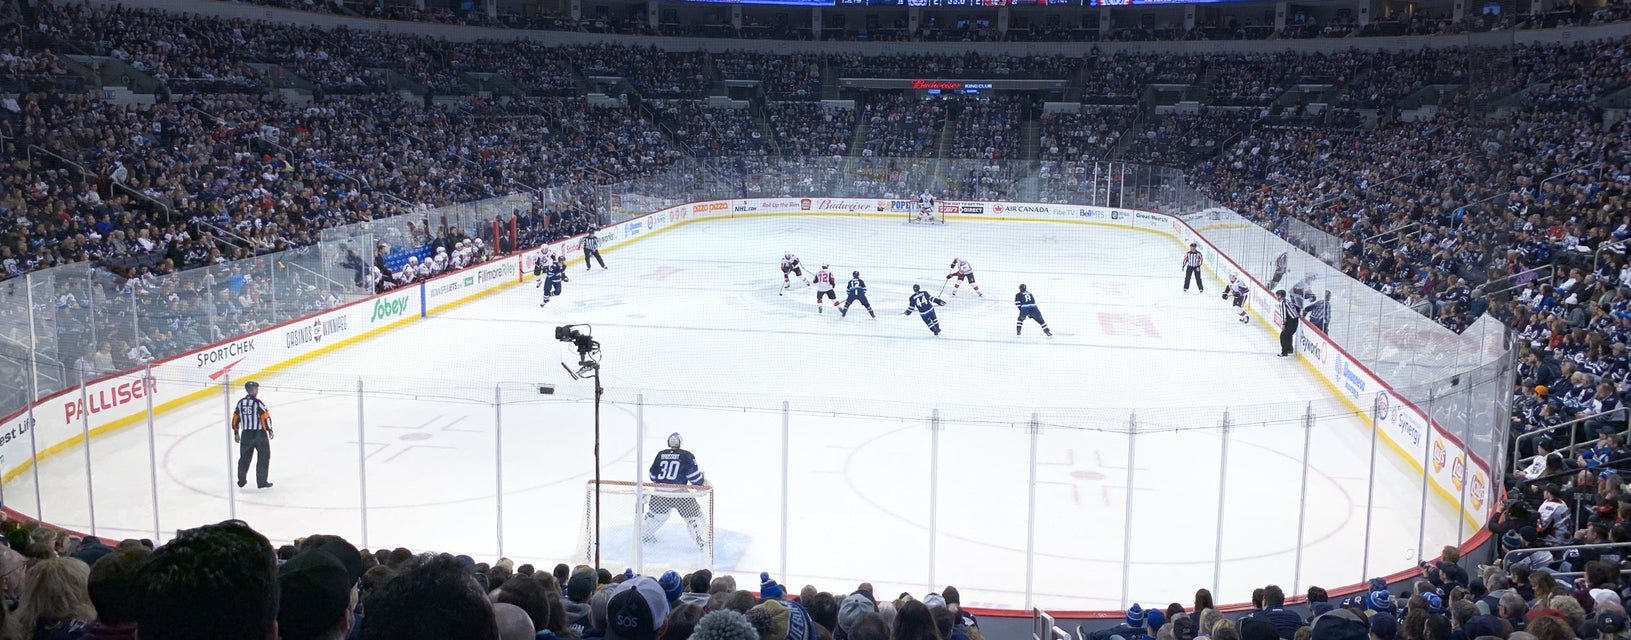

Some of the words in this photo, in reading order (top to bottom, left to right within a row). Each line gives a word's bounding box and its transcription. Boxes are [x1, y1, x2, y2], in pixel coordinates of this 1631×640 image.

[693, 204, 708, 213] pizza
[709, 202, 728, 213] pizza
[817, 199, 871, 210] Budweiser
[818, 273, 829, 283] 72
[916, 295, 928, 307] 44
[371, 295, 409, 323] Sobeys
[286, 326, 312, 349] CASINOS
[322, 315, 347, 336] WINNIPEG
[65, 376, 158, 424] PALLISER
[242, 406, 252, 415] 36
[1398, 413, 1421, 447] Synergy
[657, 460, 680, 480] 30
[617, 614, 638, 628] SOS
